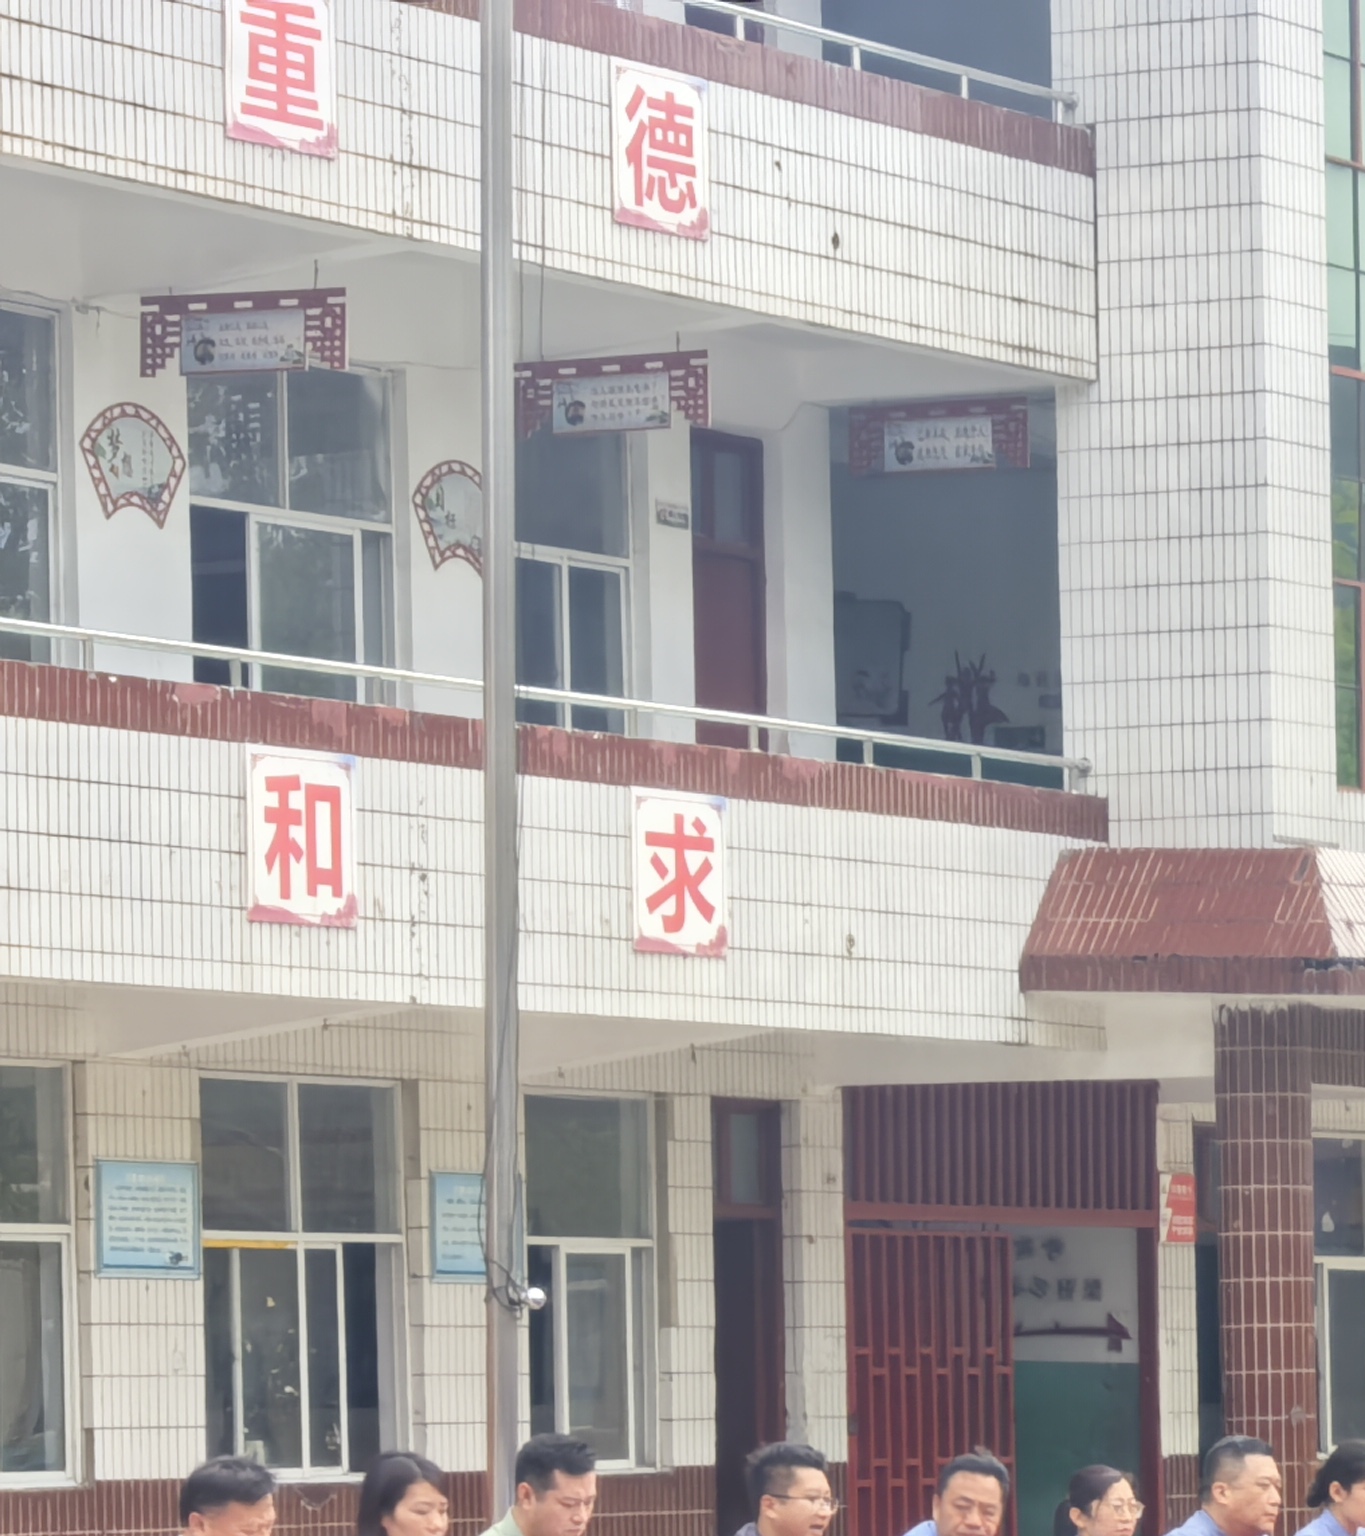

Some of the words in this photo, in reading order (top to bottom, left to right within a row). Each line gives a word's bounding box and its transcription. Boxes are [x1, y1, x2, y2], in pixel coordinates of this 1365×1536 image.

[240, 0, 324, 131] 重
[625, 84, 698, 215] 德
[263, 774, 345, 901] 和
[644, 812, 717, 934] 求
